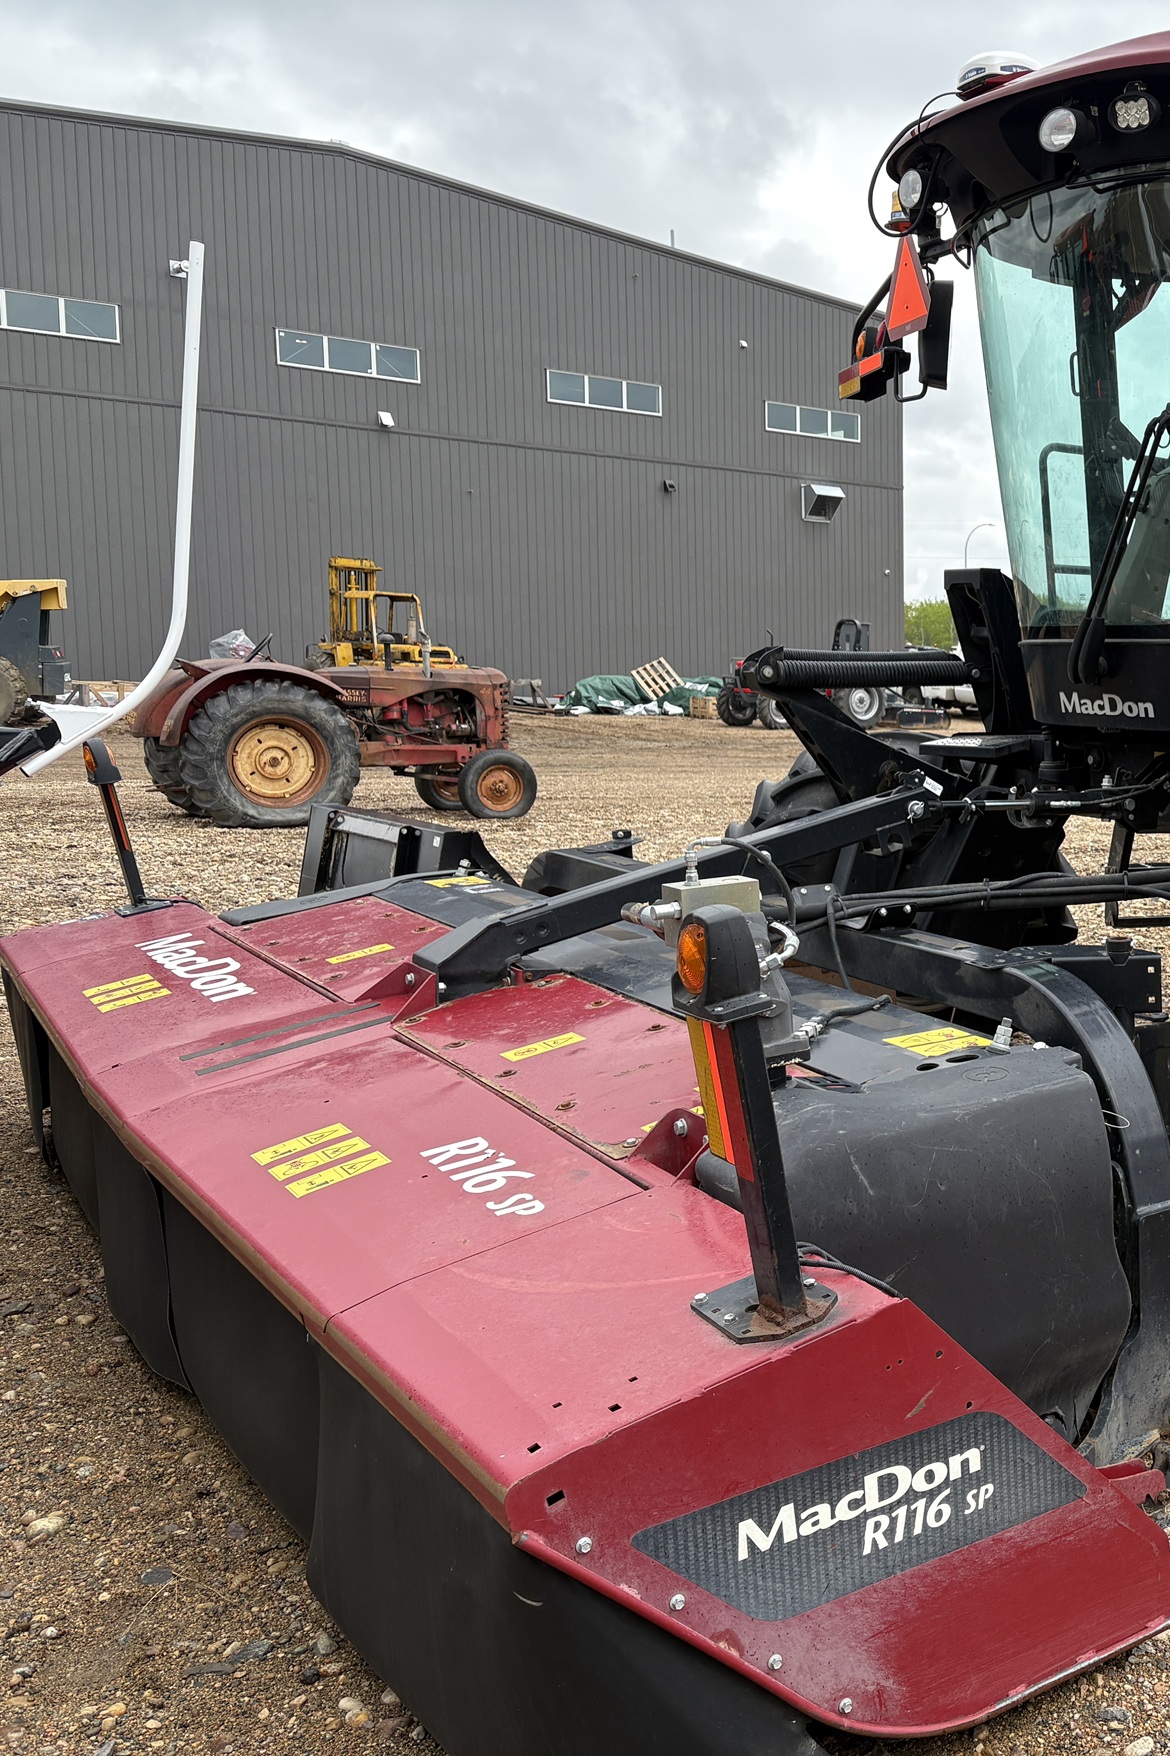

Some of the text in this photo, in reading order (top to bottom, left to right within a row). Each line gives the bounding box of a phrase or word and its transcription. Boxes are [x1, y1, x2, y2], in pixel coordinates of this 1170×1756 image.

[1059, 691, 1155, 718] MacDon
[134, 932, 255, 1003] MacDon
[419, 1136, 545, 1217] R116 SP
[737, 1446, 983, 1562] MacDon
[862, 1483, 995, 1556] R116 SP
